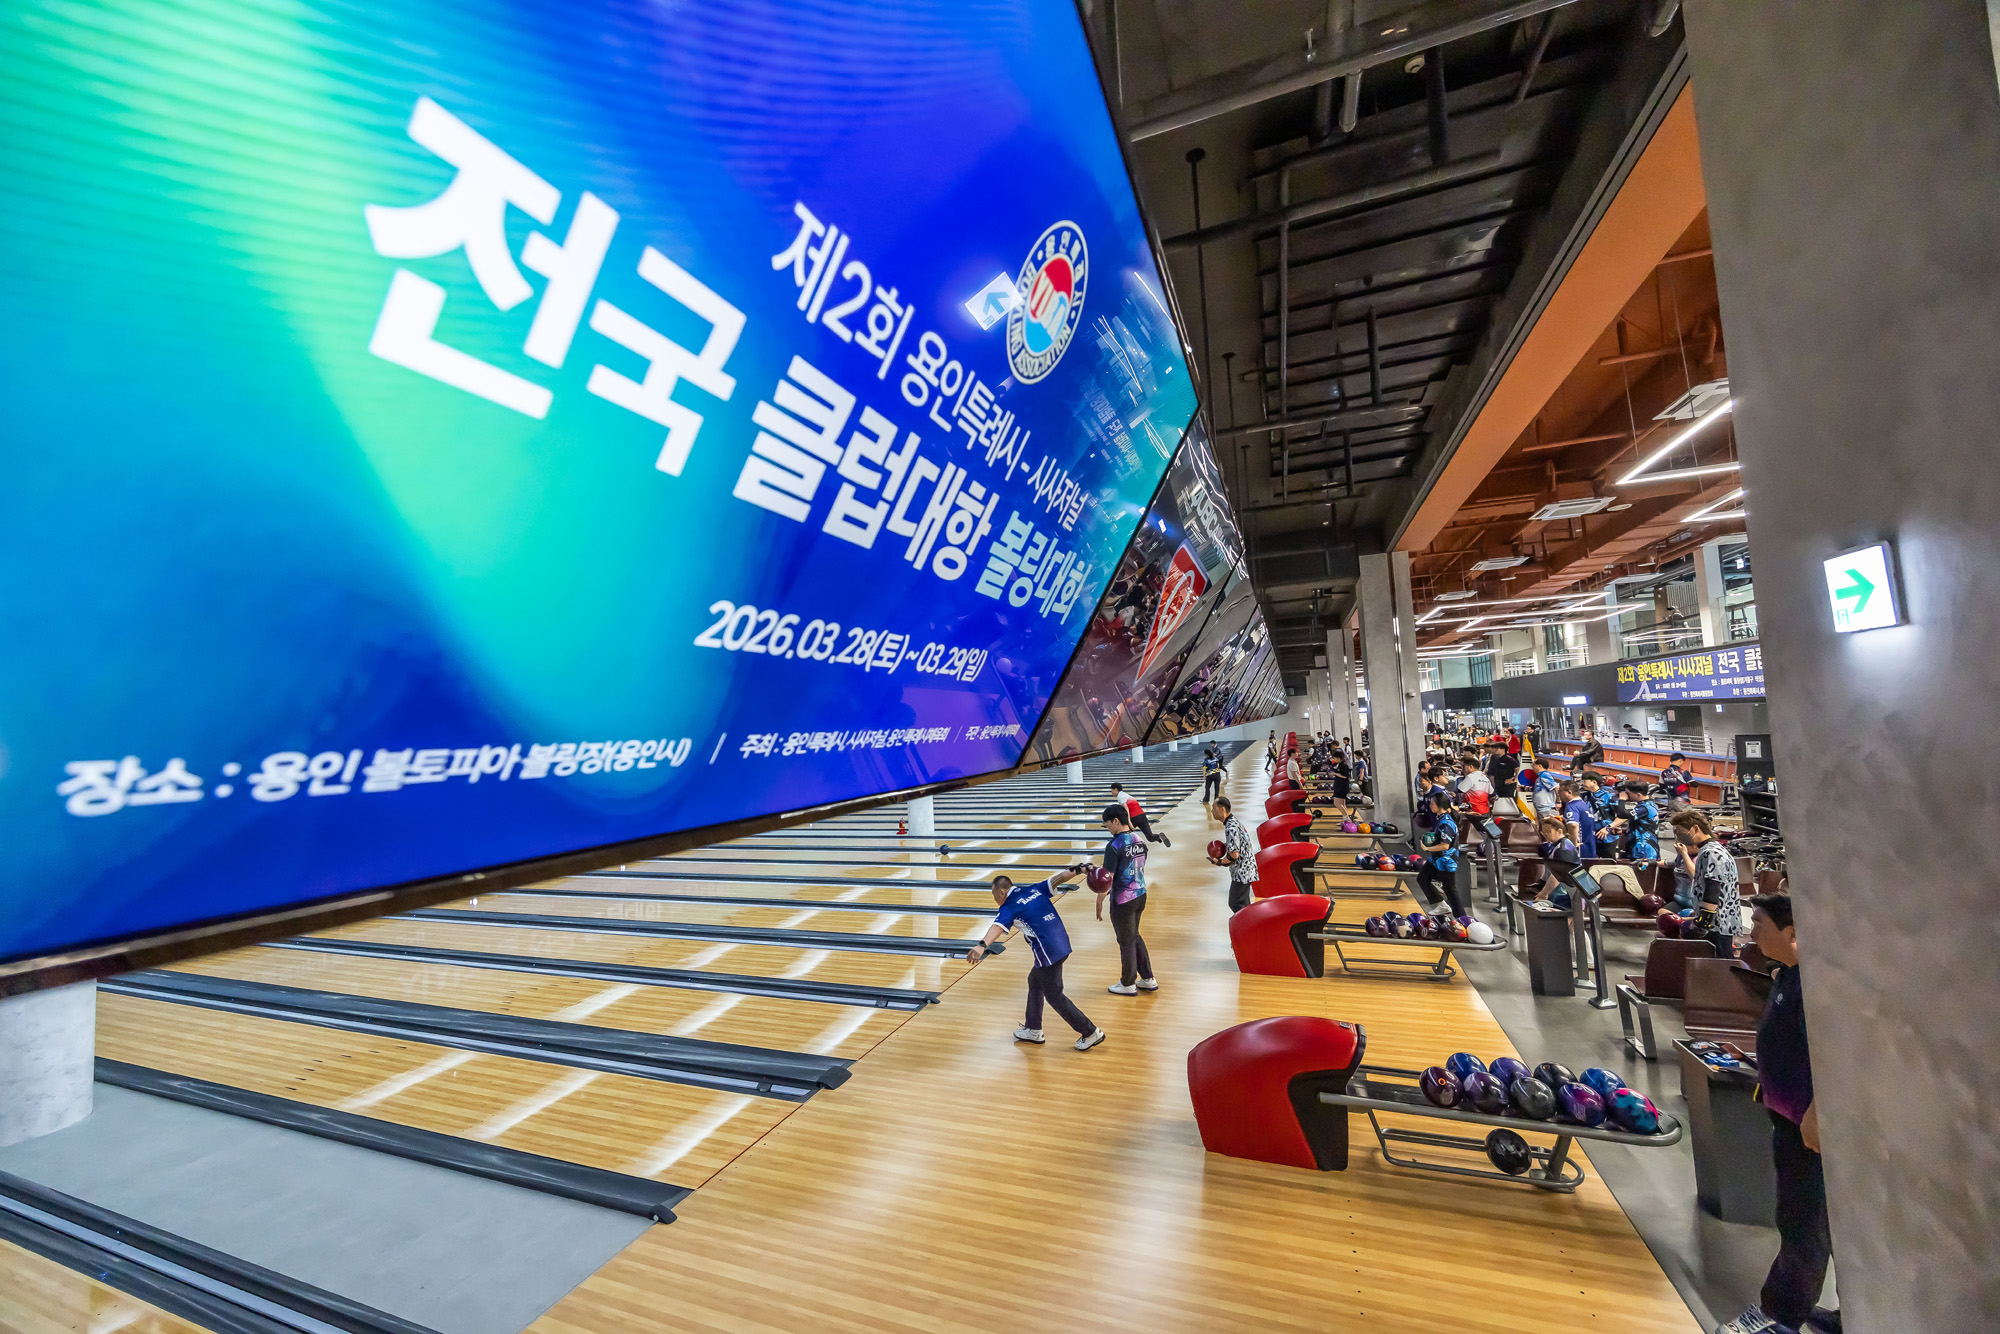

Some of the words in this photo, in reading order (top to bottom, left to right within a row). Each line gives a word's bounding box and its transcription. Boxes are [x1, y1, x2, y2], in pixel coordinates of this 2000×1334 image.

[364, 95, 747, 477] 전국
[771, 202, 914, 380] 제2회
[1010, 261, 1037, 356] BOLING
[732, 354, 999, 581] 클럽대항
[975, 510, 1093, 624] 볼링대회
[1617, 666, 1635, 683] 제2회
[1717, 651, 1740, 674] 전국
[56, 755, 204, 817] 장소
[247, 748, 364, 802] 용인
[362, 743, 522, 793] 볼토피아
[739, 732, 779, 759] 주최
